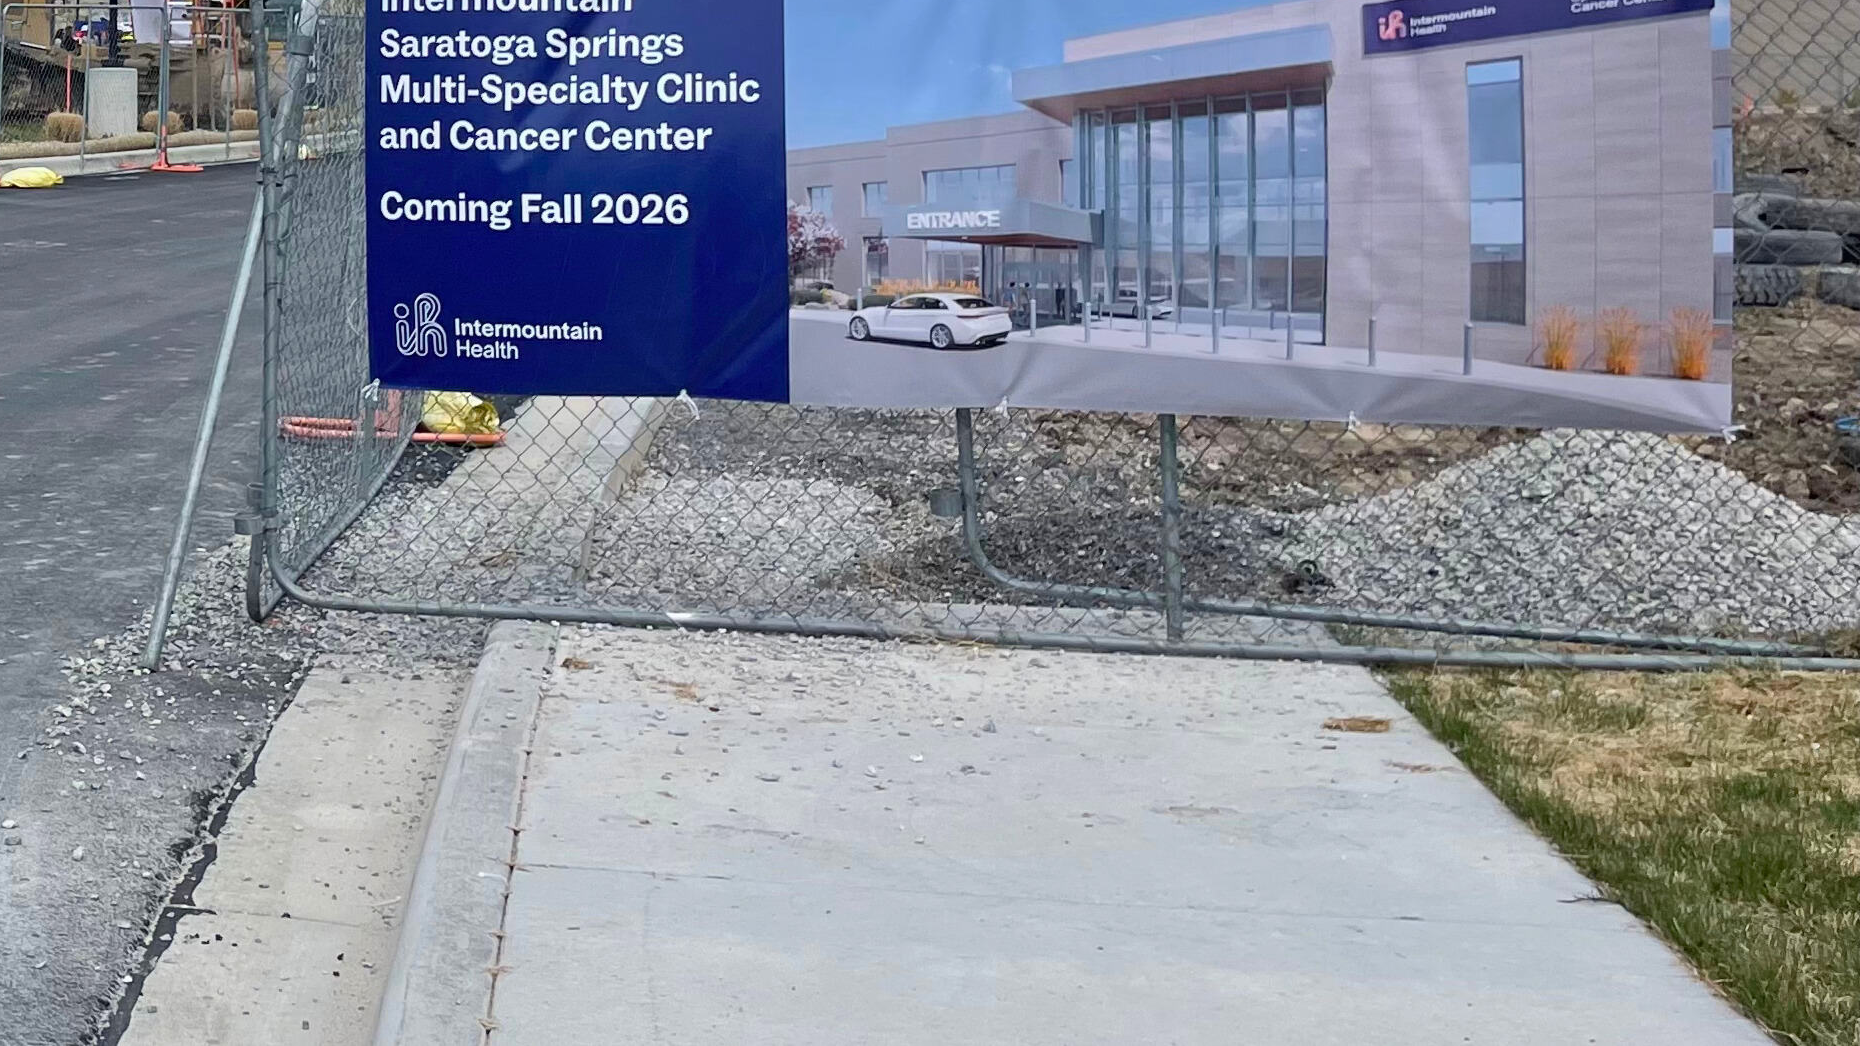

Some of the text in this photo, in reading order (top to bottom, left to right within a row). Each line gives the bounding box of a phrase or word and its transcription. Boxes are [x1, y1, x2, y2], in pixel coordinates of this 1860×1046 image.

[1410, 5, 1497, 27] Intermountain
[1410, 23, 1447, 37] Health
[381, 28, 683, 65] Saratoga Springs
[381, 73, 759, 111] Multi-Specialty Clinic
[380, 121, 712, 150] and Cancer Center
[381, 191, 688, 230] Coming Fall 2026
[906, 210, 1001, 229] ENTRANCE
[455, 318, 602, 341] Intermountain
[456, 340, 518, 359] Health
